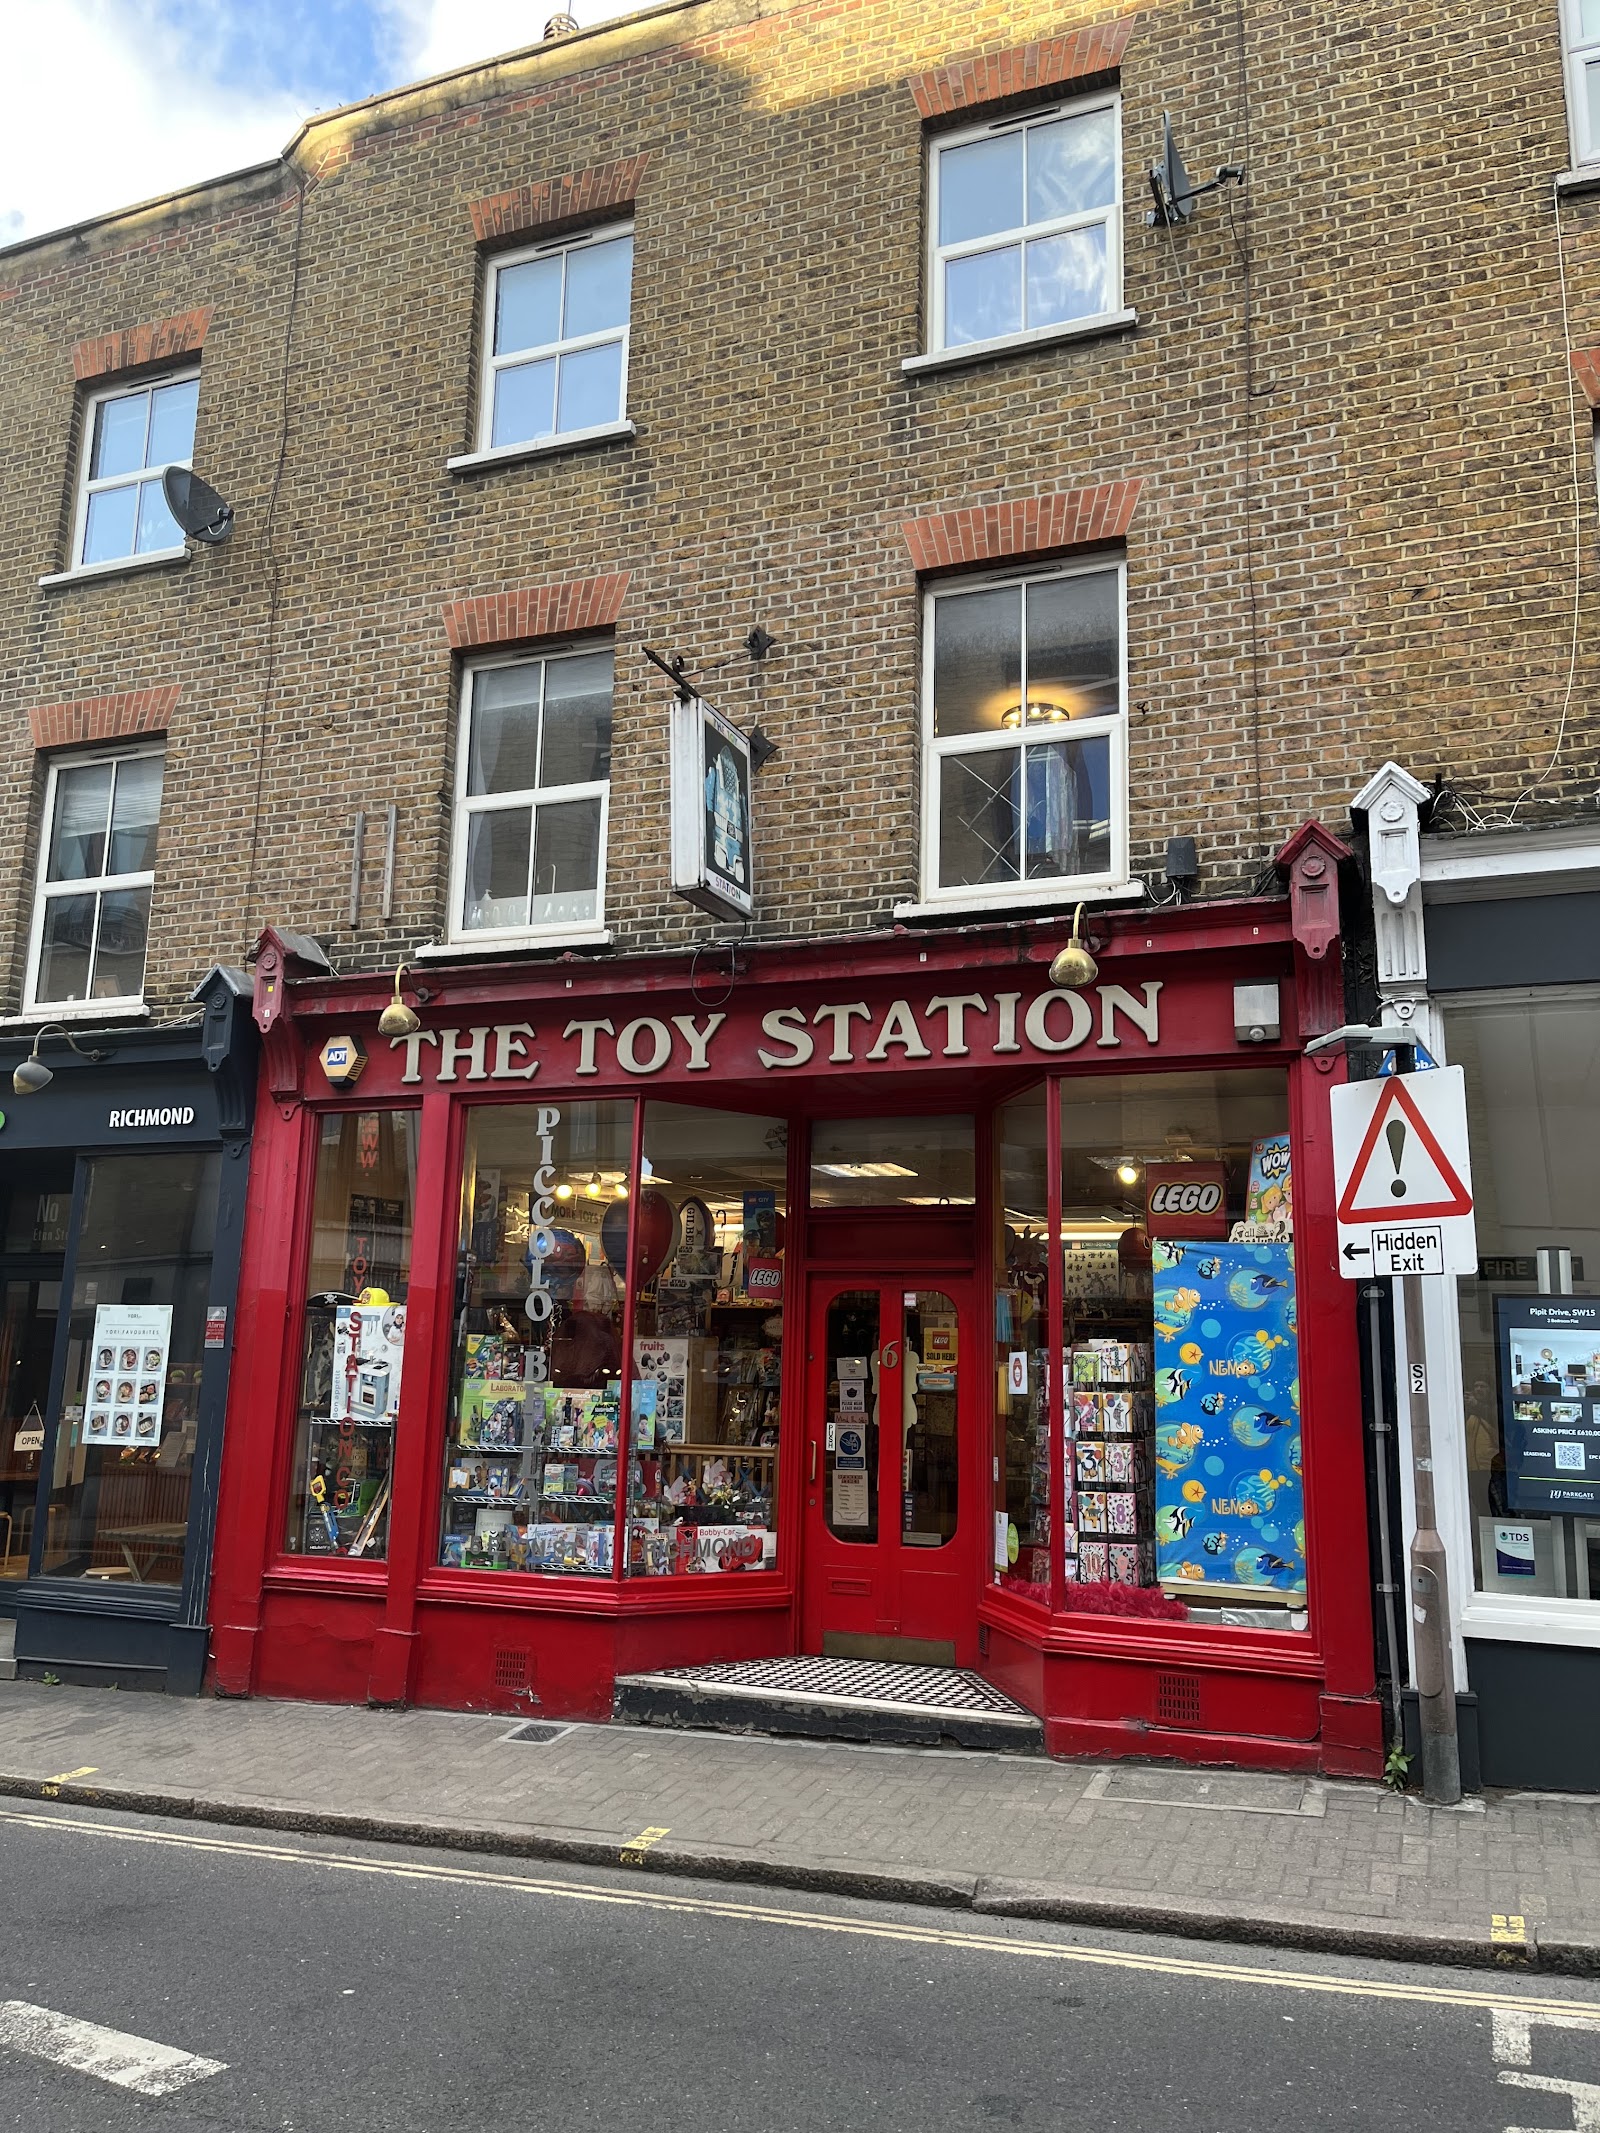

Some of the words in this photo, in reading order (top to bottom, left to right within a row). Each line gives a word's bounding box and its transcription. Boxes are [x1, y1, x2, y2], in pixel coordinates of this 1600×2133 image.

[715, 876, 741, 900] STATION
[389, 1021, 540, 1084] THE
[562, 1012, 727, 1076] TOY
[757, 981, 1164, 1069] STATION
[327, 1050, 347, 1063] ADT
[109, 1106, 195, 1128] RICHMOND
[1261, 1152, 1291, 1174] WOW
[1152, 1183, 1221, 1214] LEGO
[37, 1194, 59, 1223] No
[685, 1207, 695, 1246] GILBE
[1244, 1228, 1255, 1238] all
[1376, 1230, 1438, 1251] Hidden
[1390, 1252, 1425, 1272] Exit
[1484, 1260, 1529, 1276] FIRE
[750, 1268, 781, 1287] LEGO
[1529, 1308, 1548, 1317] Pipit
[1548, 1308, 1571, 1317] Drive,
[1572, 1309, 1596, 1317] SW15
[207, 1321, 225, 1329] Alarm
[640, 1340, 666, 1351] fruits
[934, 1336, 949, 1344] LEGO
[881, 1341, 899, 1368] 6
[926, 1352, 941, 1361] SOLD
[941, 1352, 956, 1361] HERE
[1412, 1364, 1423, 1378] S
[490, 1382, 526, 1392] LABORATO
[1414, 1379, 1423, 1392] 2
[1532, 1427, 1557, 1435] ASKING
[1557, 1428, 1576, 1436] PRICE
[21, 1436, 41, 1445] OPEN
[1562, 1491, 1595, 1499] PARKGATE
[1115, 1503, 1127, 1525] 8
[699, 1528, 735, 1537] Bobby-Car
[1508, 1532, 1530, 1542] TDS
[643, 1536, 755, 1561] RICHMOND
[1084, 1552, 1101, 1575] 10
